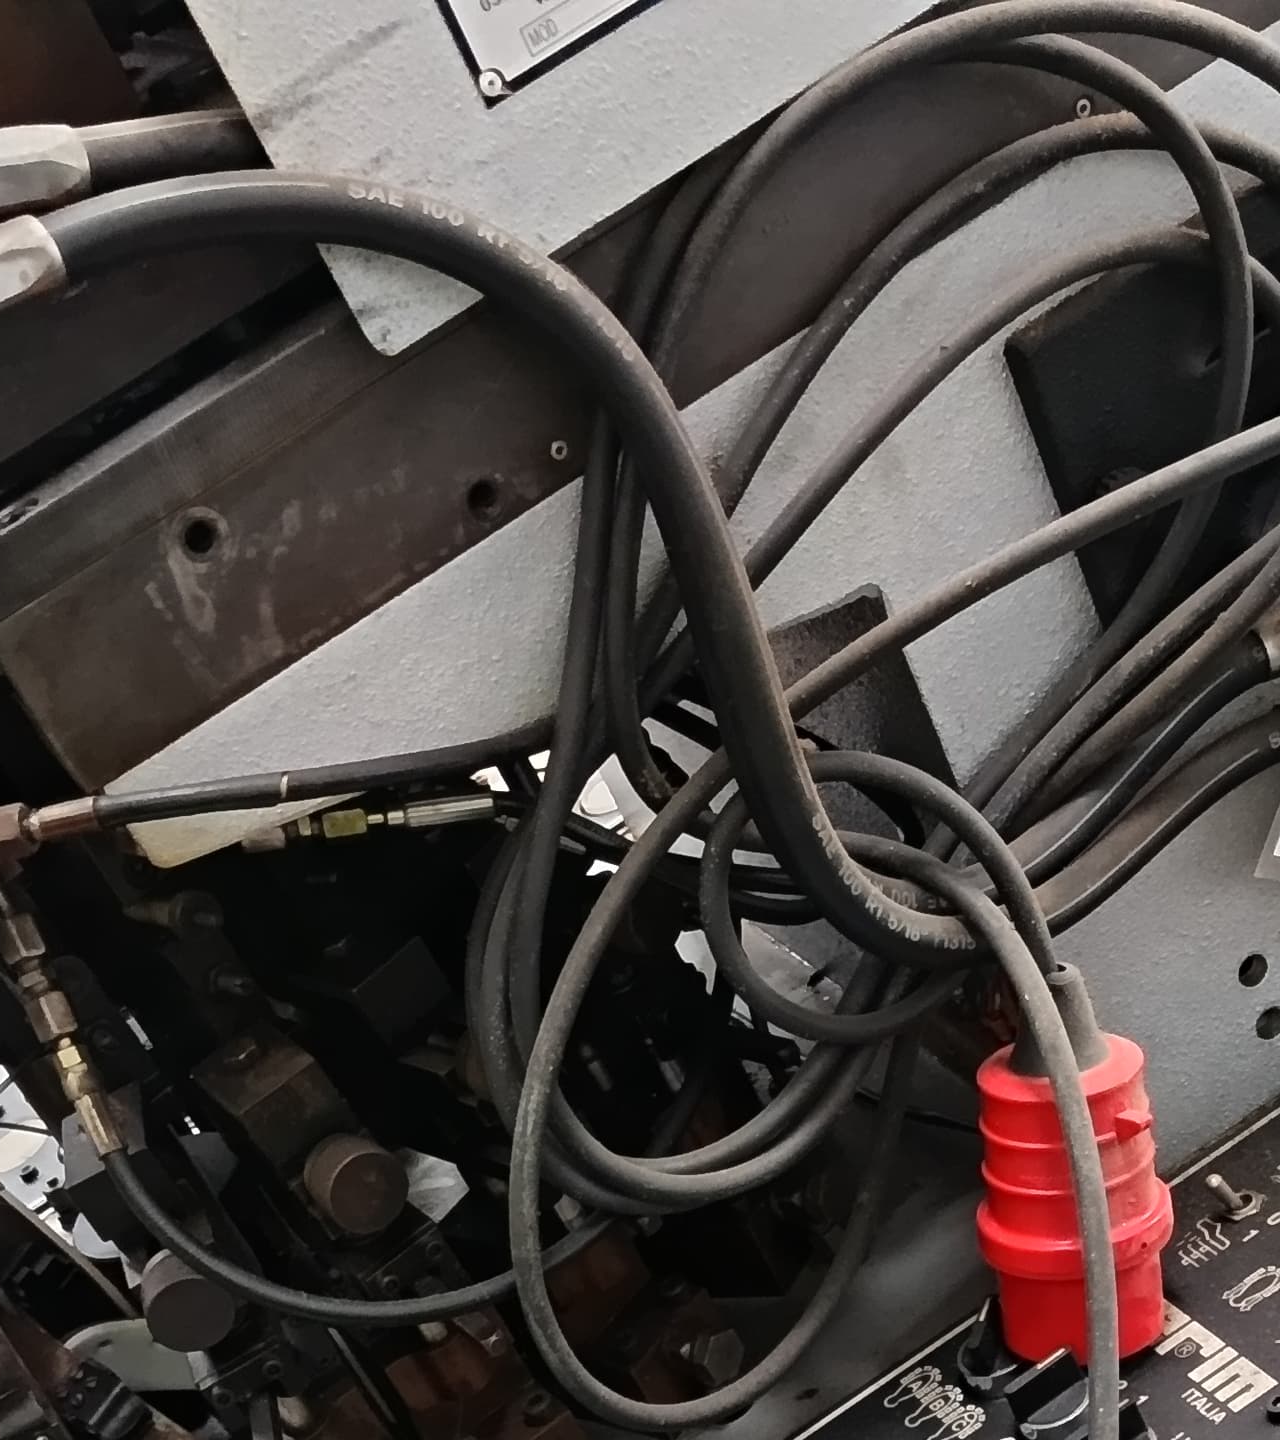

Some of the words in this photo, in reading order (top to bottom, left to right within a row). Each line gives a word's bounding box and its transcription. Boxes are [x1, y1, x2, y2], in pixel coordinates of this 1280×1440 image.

[527, 18, 559, 48] MOD
[347, 182, 404, 208] SAE
[838, 867, 862, 896] 100
[1180, 1387, 1227, 1425] ITALIA
